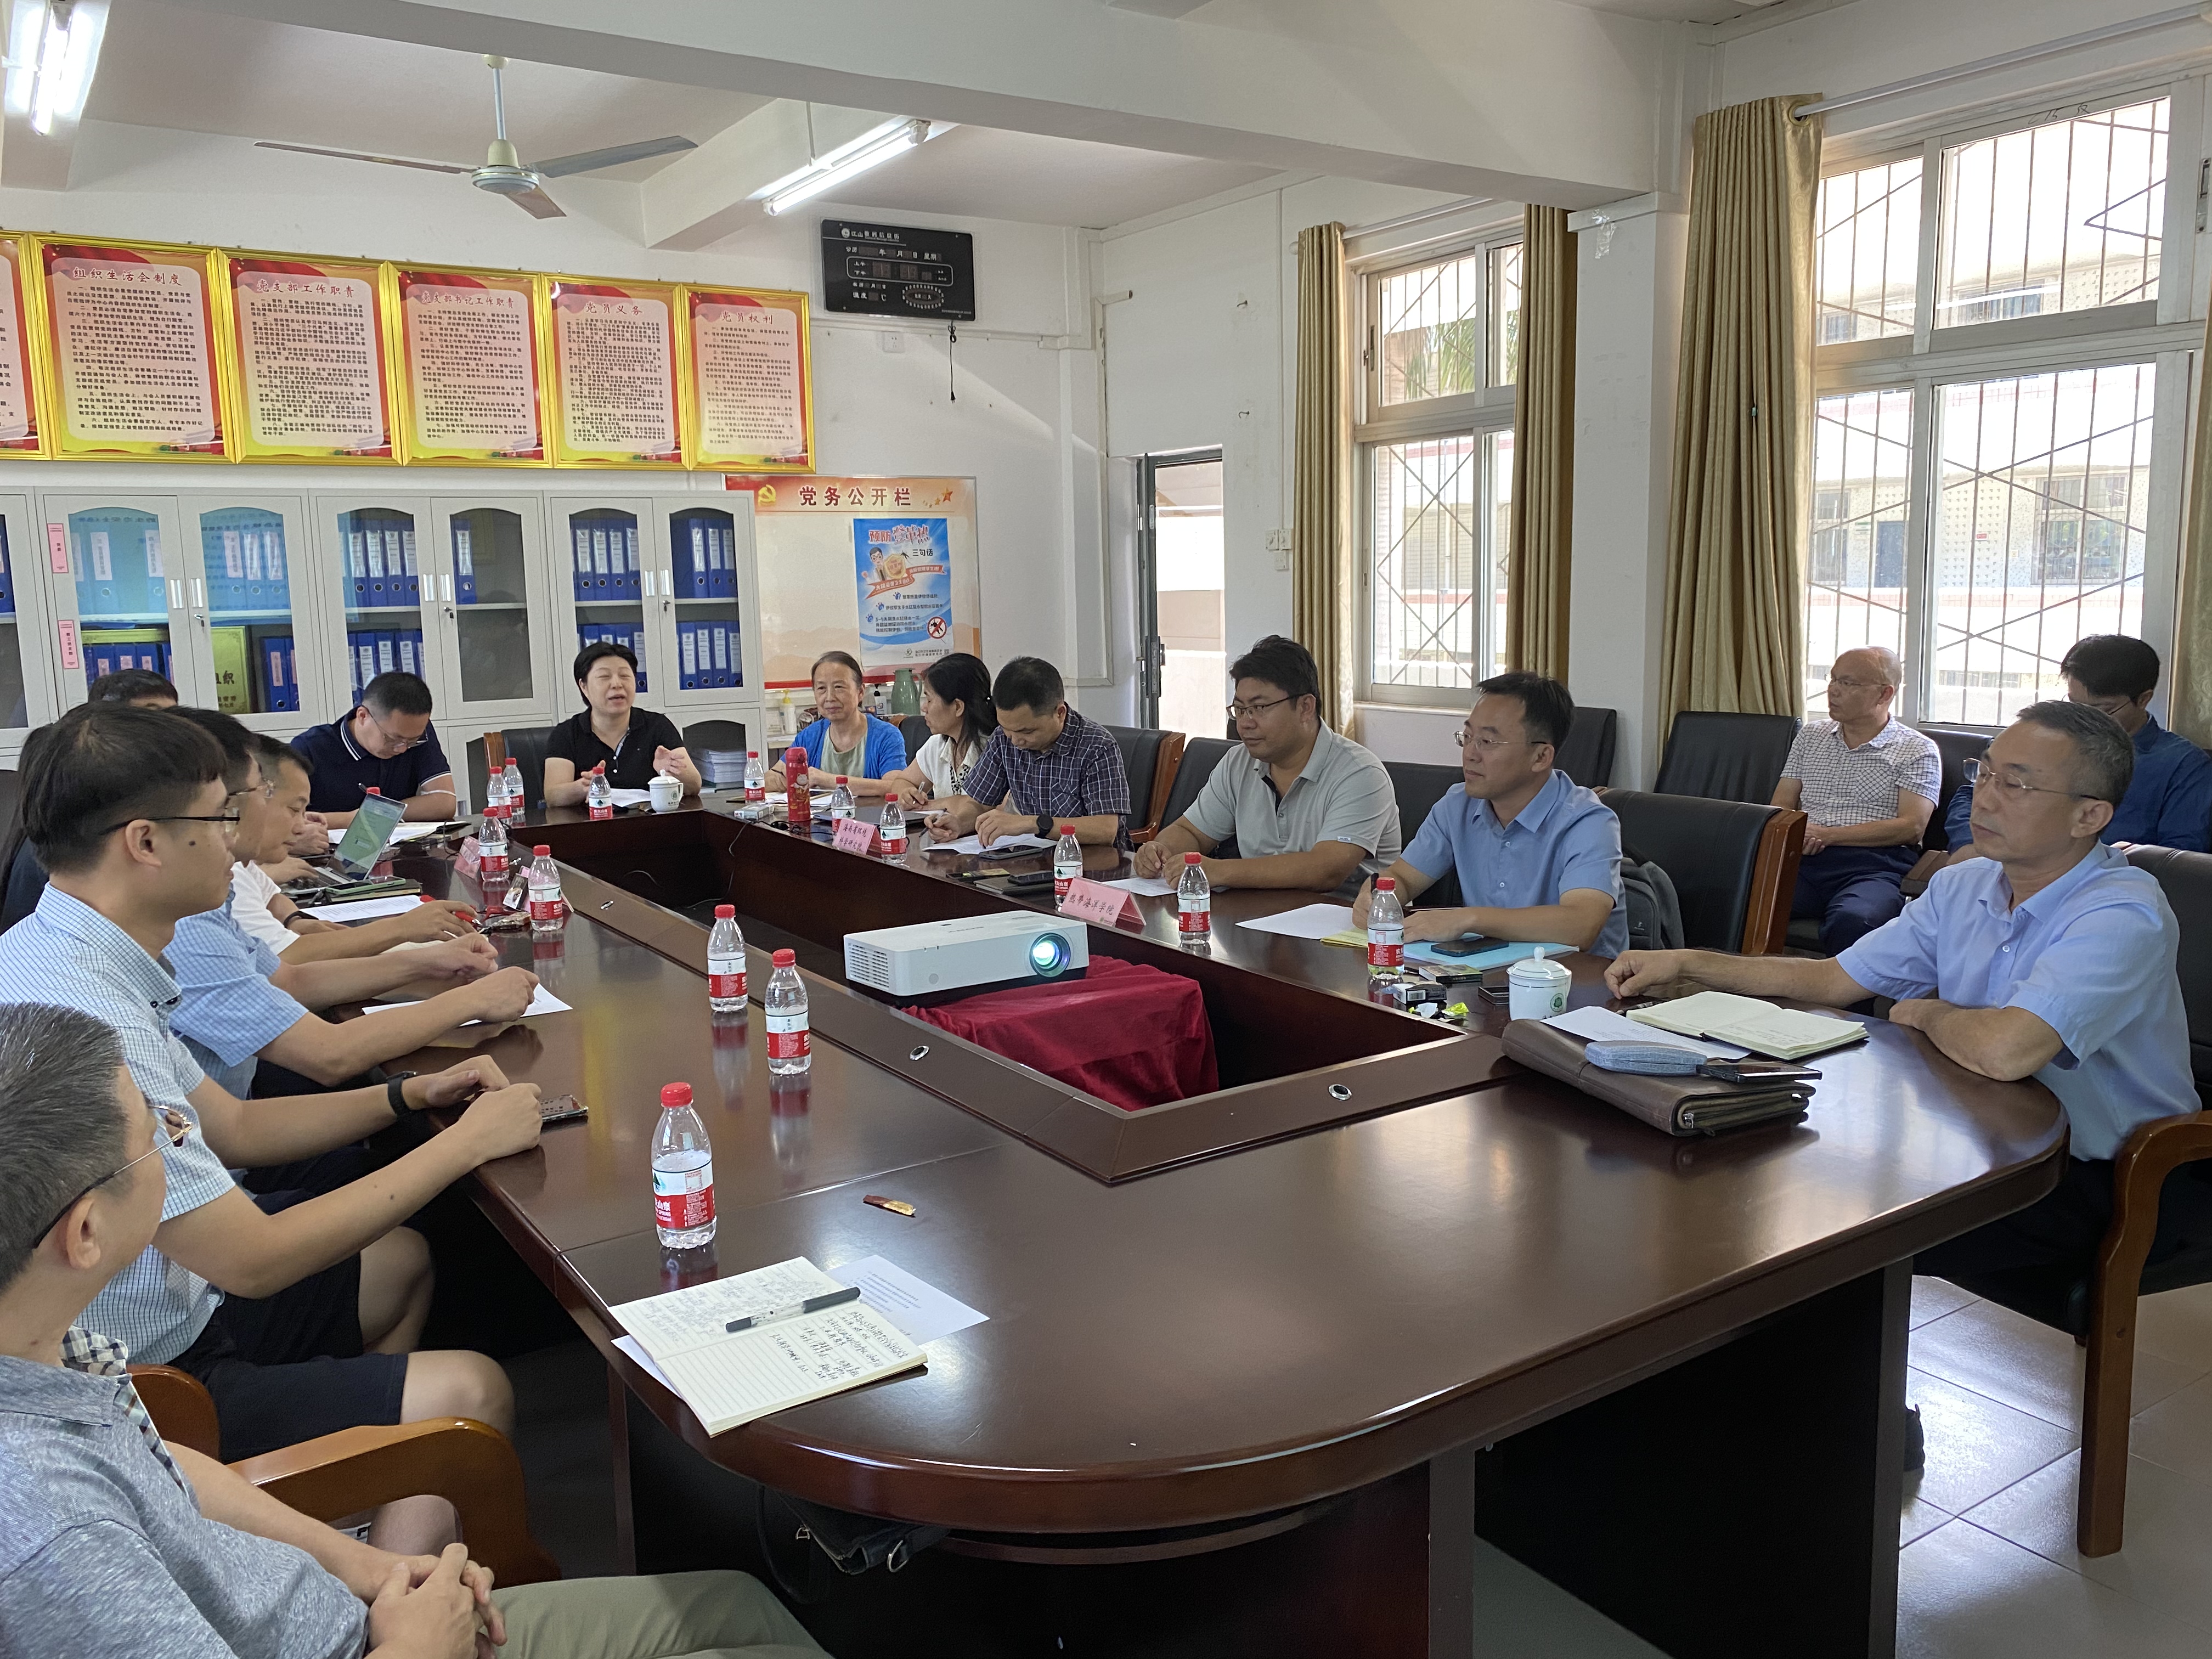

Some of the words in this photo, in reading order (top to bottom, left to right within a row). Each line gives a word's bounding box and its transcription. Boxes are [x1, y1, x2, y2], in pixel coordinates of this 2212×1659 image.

[73, 267, 182, 286] 组织生活会制度
[257, 279, 354, 298] 党支部工作职责
[421, 290, 514, 309] 党支部书记工作职责
[585, 301, 643, 316] 党员义务
[721, 310, 774, 325] 党员权利
[799, 486, 911, 506] 党务公开栏
